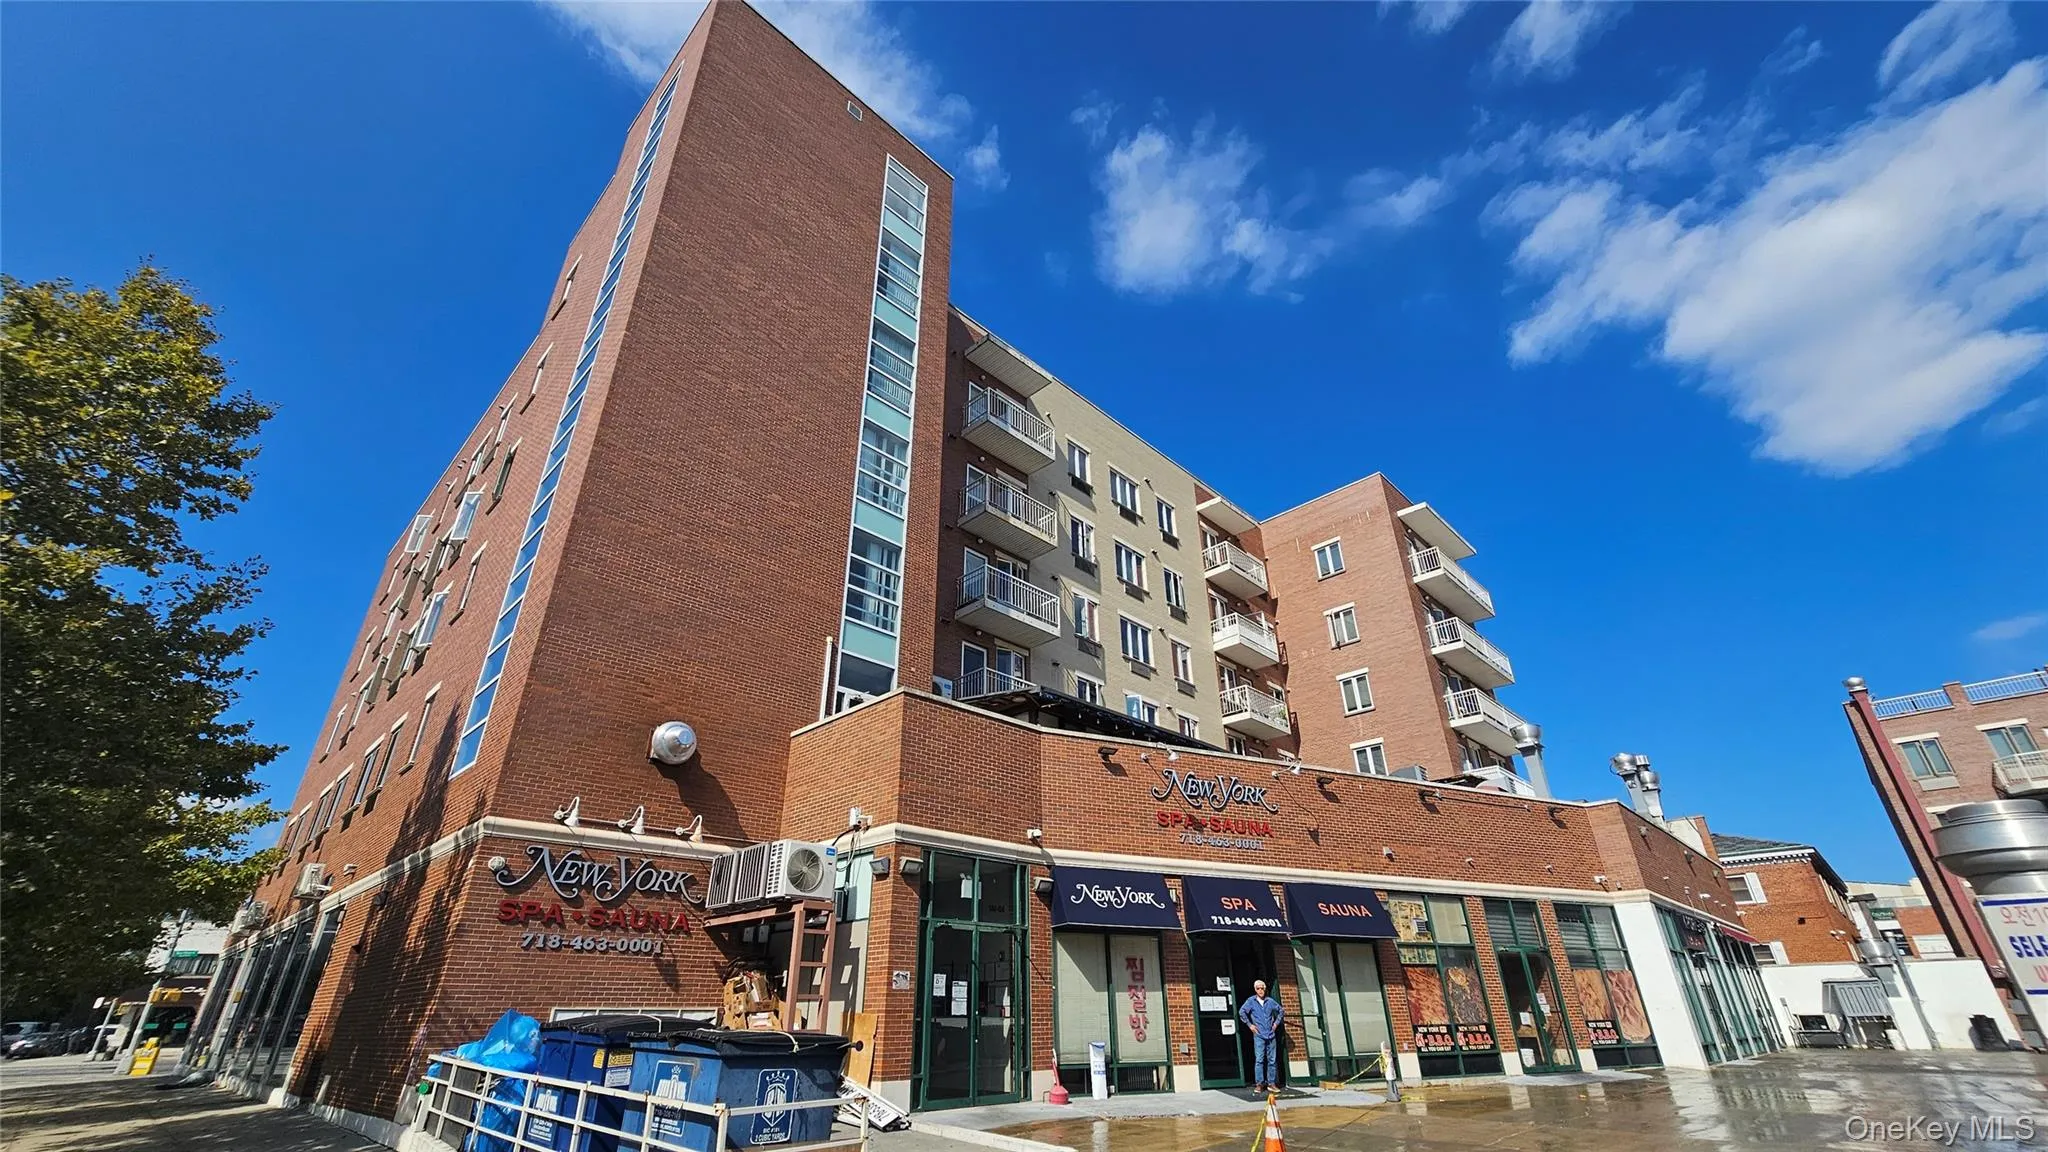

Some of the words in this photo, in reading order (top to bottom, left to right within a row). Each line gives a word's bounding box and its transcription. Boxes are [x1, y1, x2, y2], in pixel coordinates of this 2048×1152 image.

[1156, 810, 1198, 829] SPA
[1210, 816, 1275, 838] SAUNA
[1220, 897, 1257, 912] SPA
[1318, 902, 1373, 918] SAUNA
[497, 899, 563, 925] SPA
[587, 907, 690, 934] SAUNA
[1210, 915, 1283, 928] 718-463-0001
[520, 932, 663, 955] 718-463-0001
[1125, 957, 1149, 1043] 찜질방
